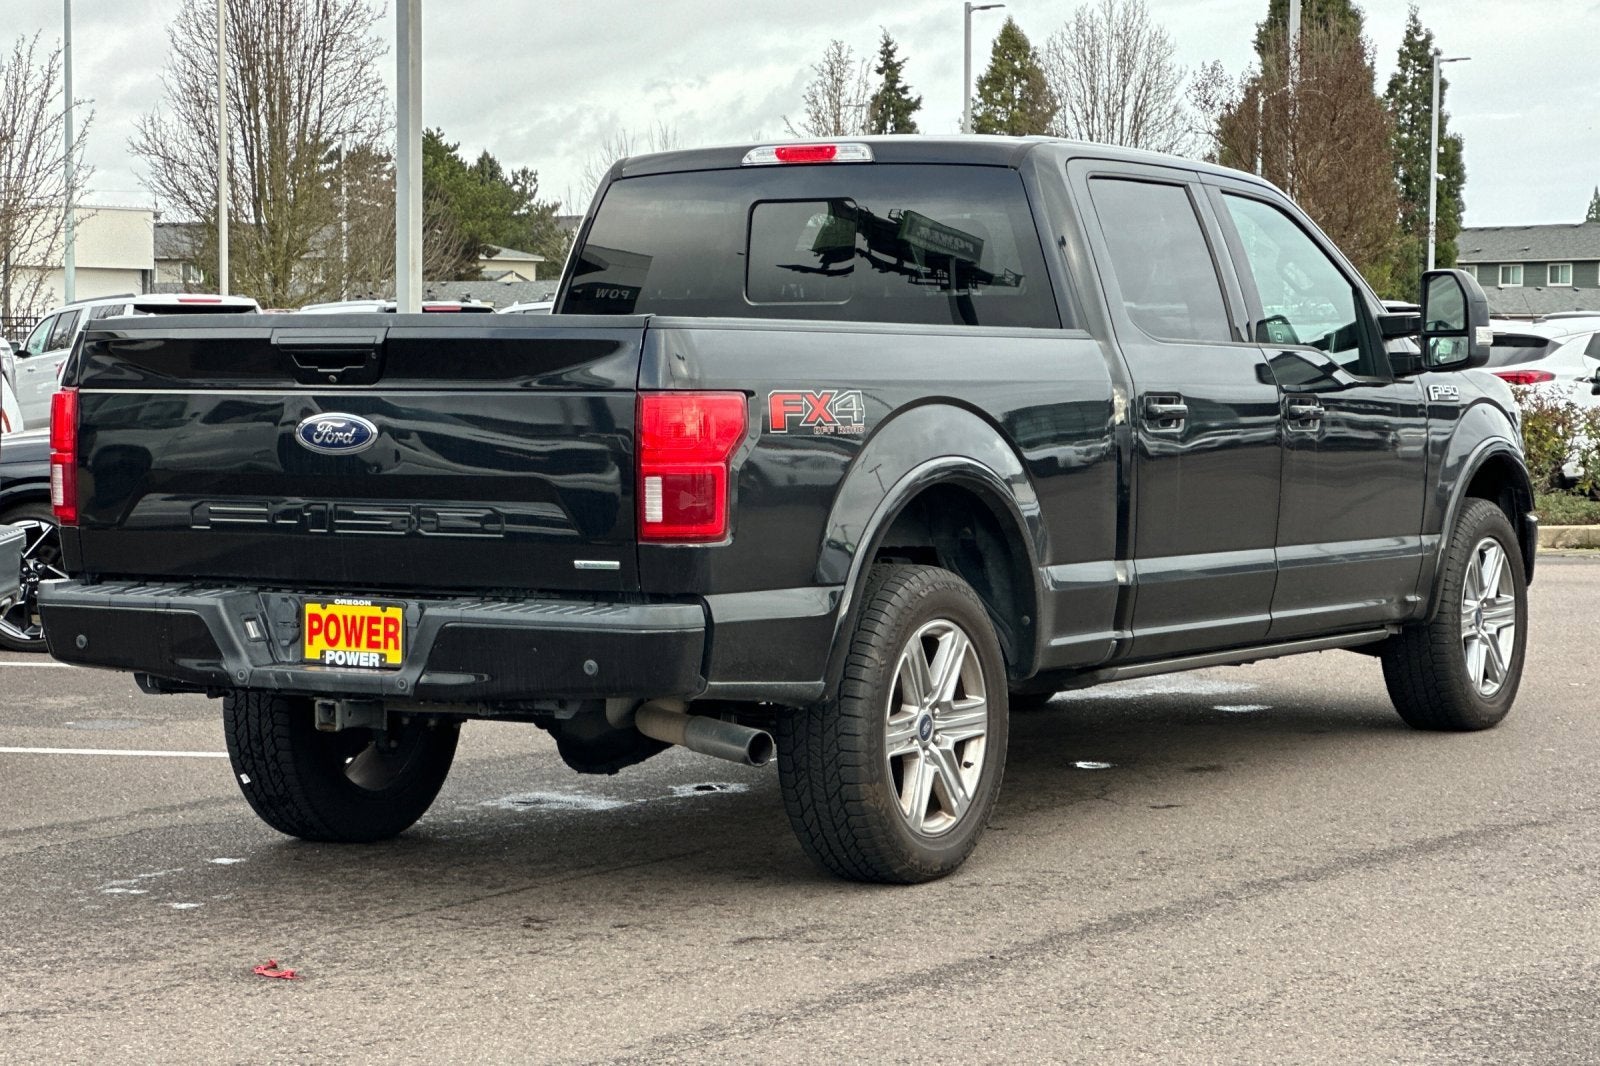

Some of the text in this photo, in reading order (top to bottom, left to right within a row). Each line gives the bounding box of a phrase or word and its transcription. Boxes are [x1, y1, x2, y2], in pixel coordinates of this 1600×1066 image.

[768, 390, 866, 433] FX4
[313, 421, 357, 444] Ford
[333, 598, 372, 606] OREGON
[307, 612, 400, 650] POWER
[325, 650, 380, 667] POWER
